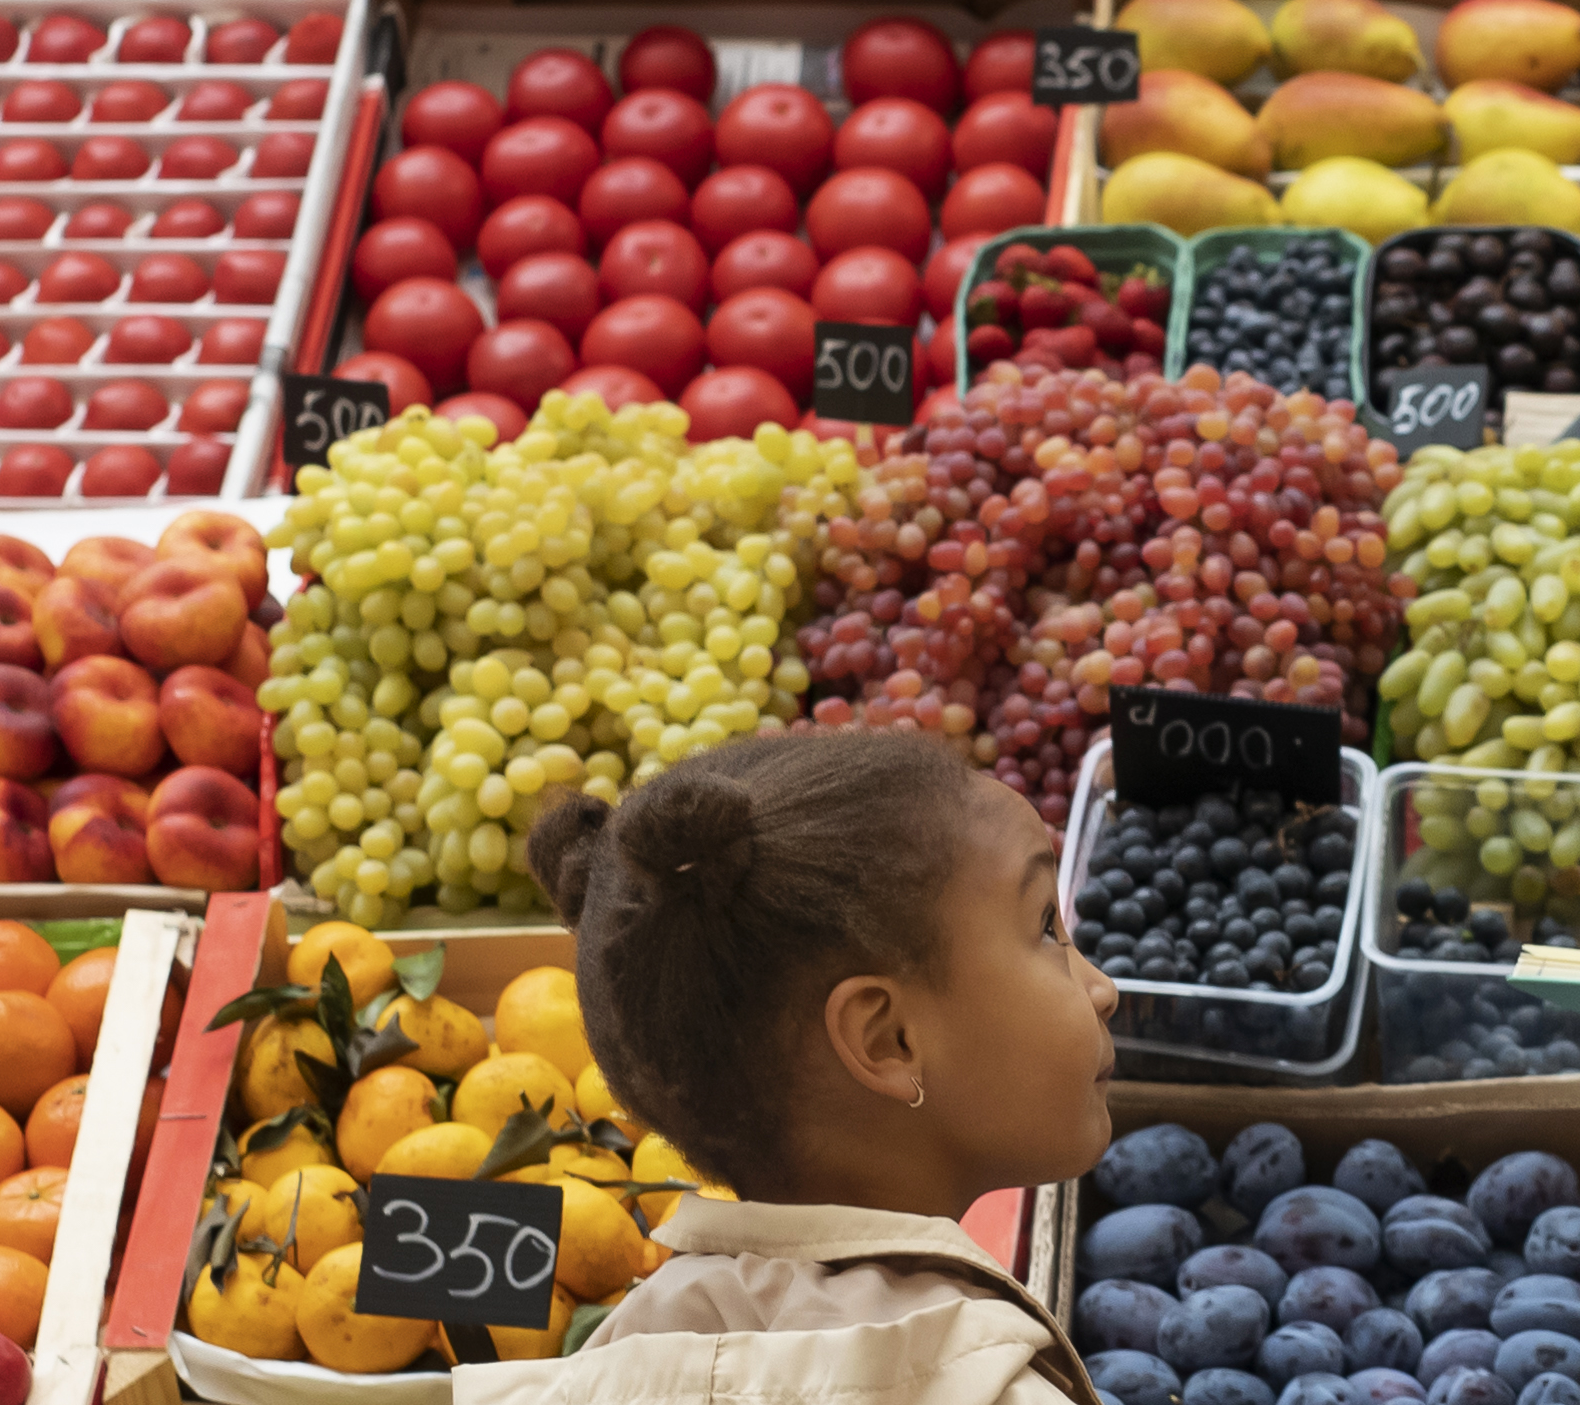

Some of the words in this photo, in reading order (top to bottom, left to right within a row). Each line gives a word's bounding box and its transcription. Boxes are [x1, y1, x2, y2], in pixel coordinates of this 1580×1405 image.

[1036, 41, 1139, 91] 350
[816, 339, 908, 393] 500
[1391, 381, 1480, 436] 500
[372, 1199, 556, 1298] 350
